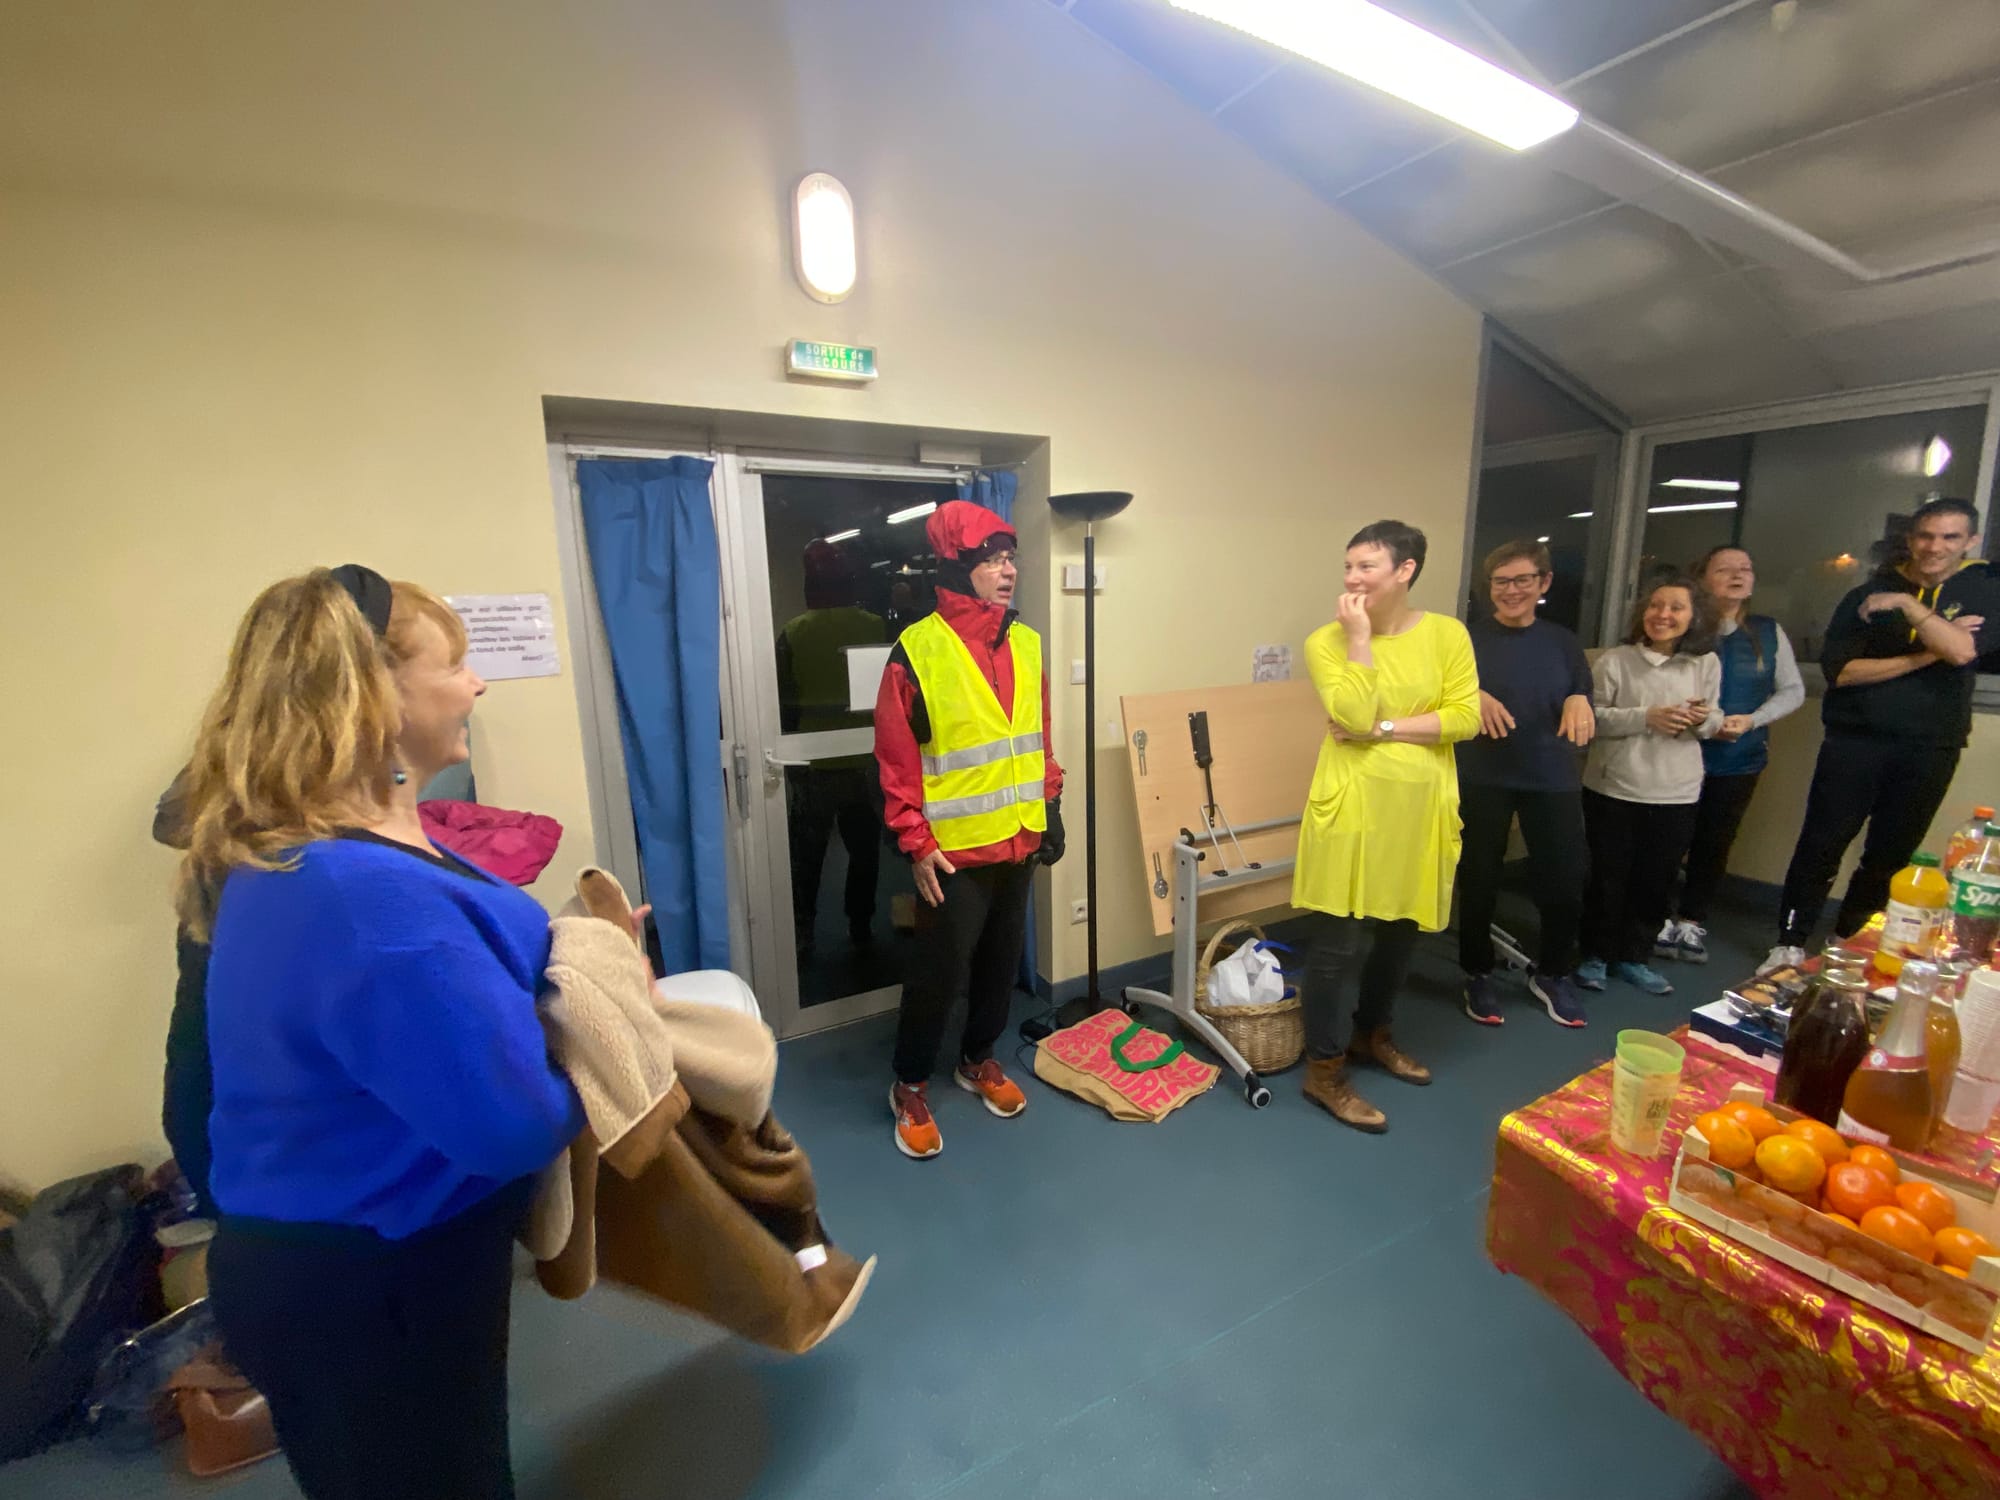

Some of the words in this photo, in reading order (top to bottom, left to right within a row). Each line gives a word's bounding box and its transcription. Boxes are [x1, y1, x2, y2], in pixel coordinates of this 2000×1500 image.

[805, 343, 847, 360] SORTIE
[851, 349, 864, 361] de
[806, 355, 865, 372] SECOURS
[1960, 885, 2000, 907] Spr
